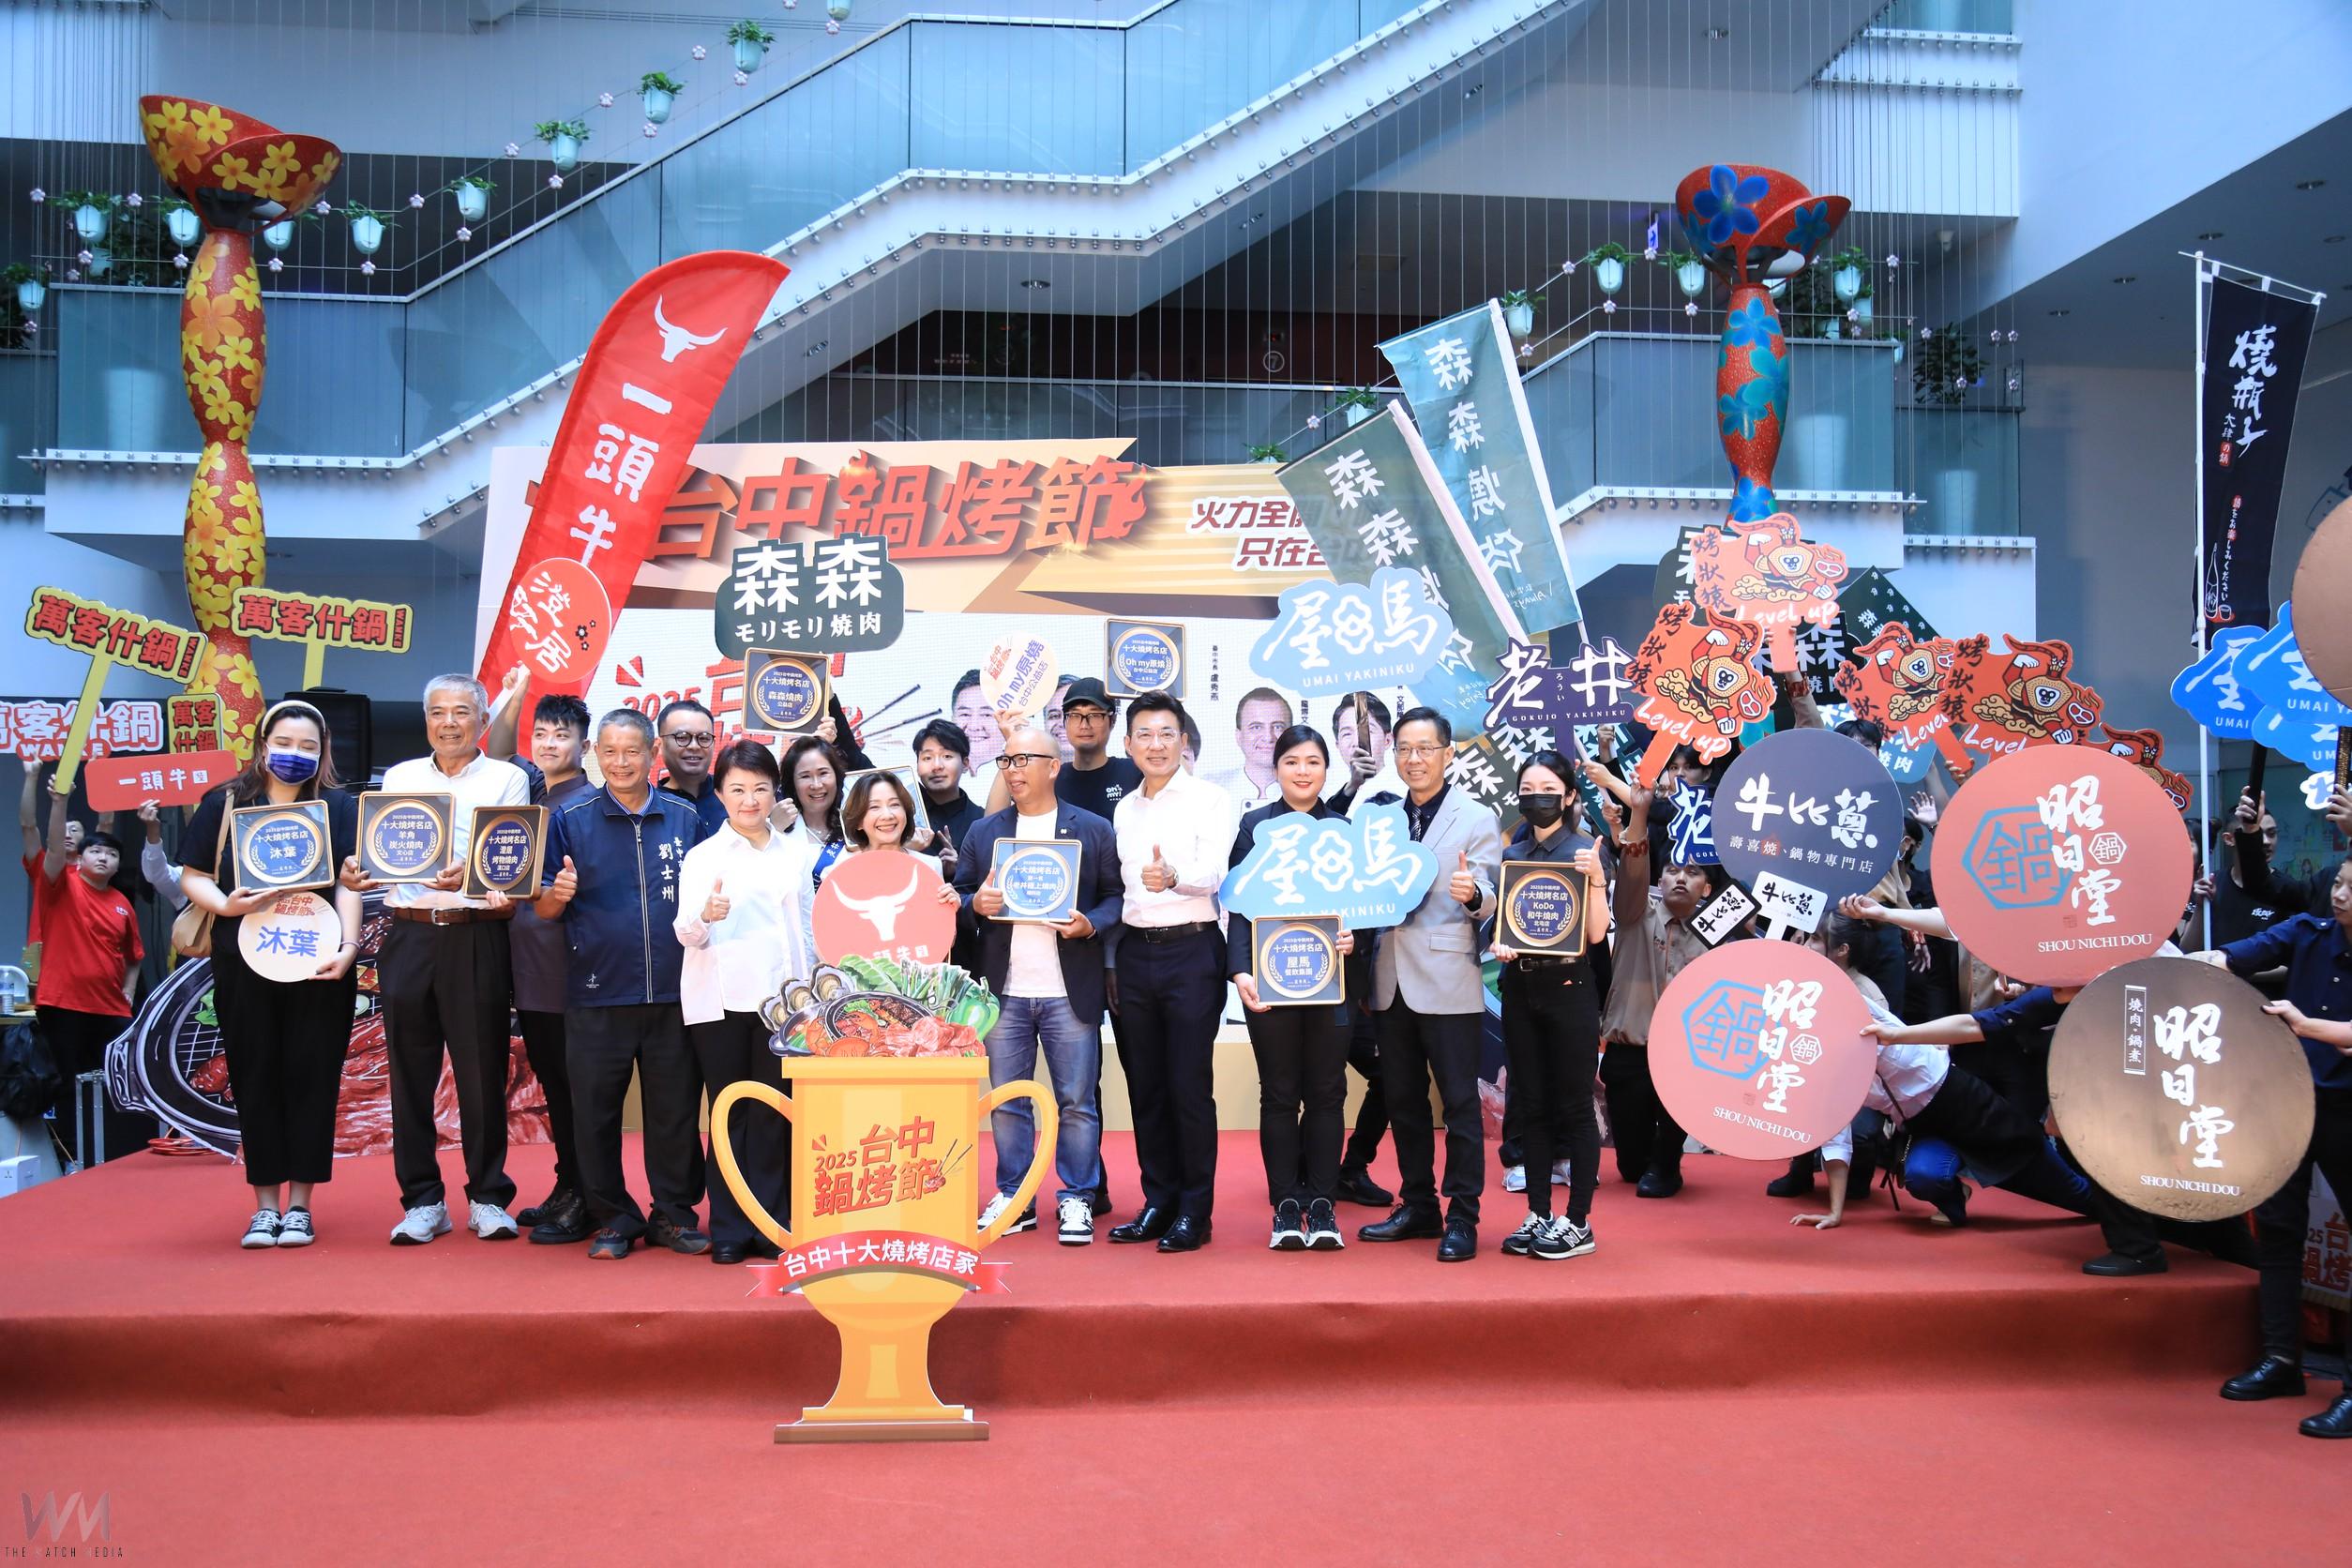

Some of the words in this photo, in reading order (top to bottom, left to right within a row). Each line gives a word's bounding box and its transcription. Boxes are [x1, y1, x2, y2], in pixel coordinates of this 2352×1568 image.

[570, 383, 673, 565] 一頭牛
[652, 455, 1148, 561] 台中鍋烤節
[1191, 501, 1304, 529] 火力全
[734, 539, 882, 615] 森森
[238, 595, 388, 645] 萬客什鍋
[392, 608, 406, 648] WANKE
[735, 611, 882, 643] モリモリ焼肉
[1808, 601, 1838, 625] up
[32, 595, 181, 671] 萬客什鍋
[177, 636, 200, 678] WANKE
[763, 676, 810, 688] 十大燒烤名店
[1303, 673, 1339, 687] UMAI
[1345, 664, 1415, 683] YAKINIKU
[1486, 640, 1636, 727] 老井
[173, 700, 217, 728] 萬客
[1512, 713, 1558, 722] GOKUJO
[1566, 709, 1626, 719] YAKINIKU
[2287, 699, 2329, 713] UMAI
[1637, 697, 1694, 740] Level
[1696, 734, 1728, 761] up
[1903, 714, 1949, 747] Level
[1964, 723, 2026, 753] Level
[2215, 716, 2249, 729] UMAI
[173, 730, 218, 753] 什鍋
[118, 768, 188, 791] 一頭牛
[381, 821, 432, 830] 十大燒烤名店
[270, 846, 296, 859] 沐葉
[2036, 775, 2122, 926] 昭日堂
[658, 843, 674, 903] 劉士州
[1520, 891, 1568, 900] 十大燒烤名店
[1527, 912, 1559, 920] 和牛燒肉
[256, 925, 320, 957] 沐葉
[1274, 943, 1323, 953] 十大燒烤名店
[2038, 939, 2077, 953] SHOU
[2079, 936, 2118, 949] NICHI
[2121, 933, 2152, 946] DOU
[1287, 957, 1310, 968] 屋馬
[1756, 979, 1823, 1113] 昭日堂
[2153, 1003, 2235, 1168] 昭日堂
[1713, 1106, 1747, 1125] SHOU
[1747, 1115, 1782, 1137] NICHI
[1783, 1127, 1811, 1144] DOU
[814, 1151, 857, 1173] 2025
[860, 1115, 936, 1166] 台中
[813, 1158, 946, 1218] 鍋烤節
[2140, 1174, 2174, 1188] SHOU
[2176, 1180, 2210, 1193] NICHI
[2212, 1184, 2240, 1197] DOU
[783, 1237, 982, 1277] 台中十大燒烤店家
